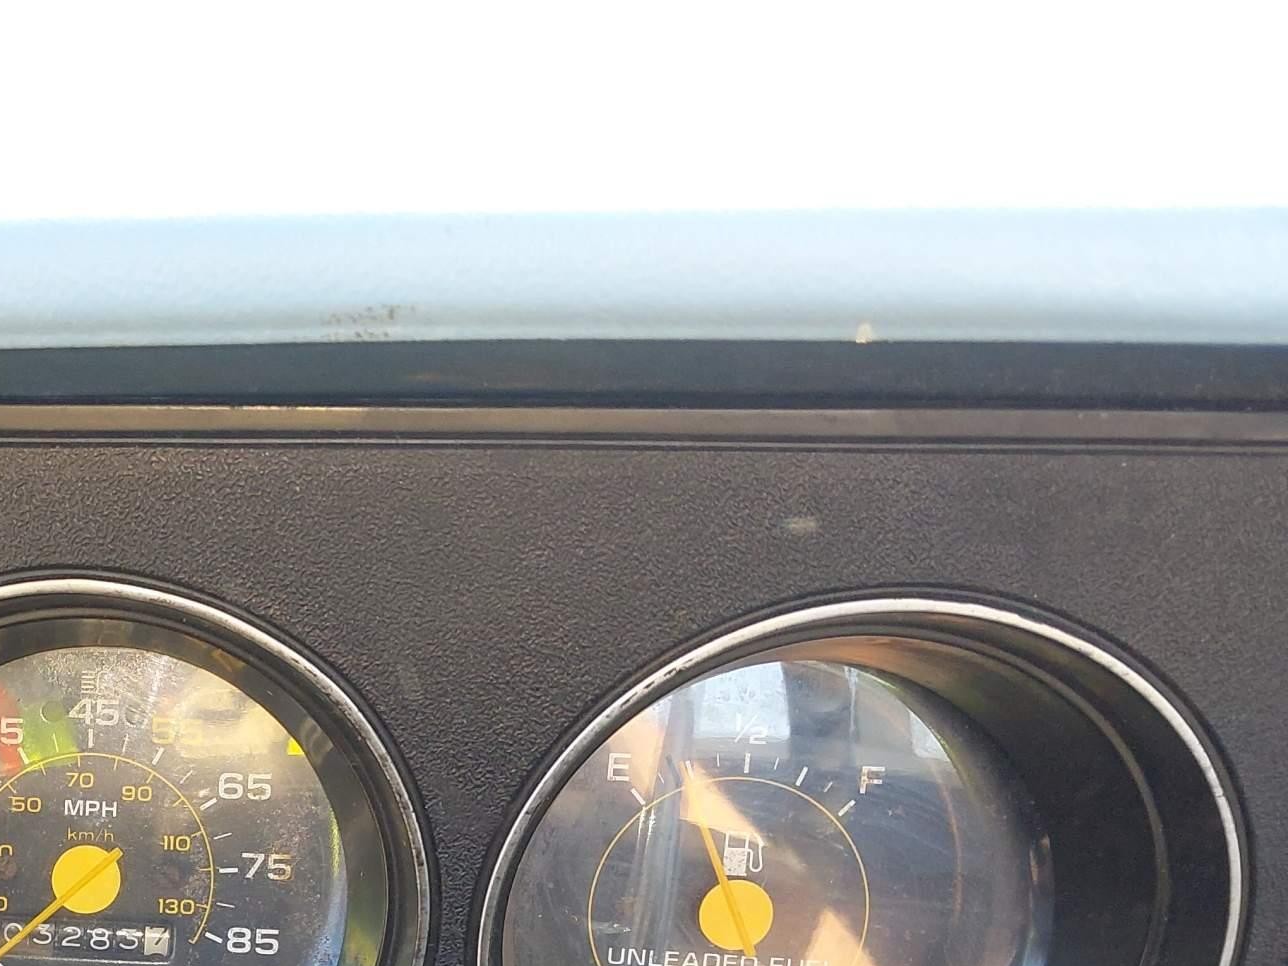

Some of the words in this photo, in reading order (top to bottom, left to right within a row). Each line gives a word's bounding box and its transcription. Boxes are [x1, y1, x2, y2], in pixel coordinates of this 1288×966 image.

[69, 699, 120, 726] 45
[607, 753, 631, 781] E
[66, 772, 95, 788] 70
[218, 772, 272, 801] 65
[859, 765, 886, 794] F
[122, 786, 153, 802] 90
[12, 796, 43, 813] 50
[64, 799, 118, 818] MPH
[67, 828, 115, 842] km/h
[163, 836, 191, 851] 110
[241, 853, 293, 881] 75
[158, 898, 196, 915] 130
[227, 927, 280, 955] 85
